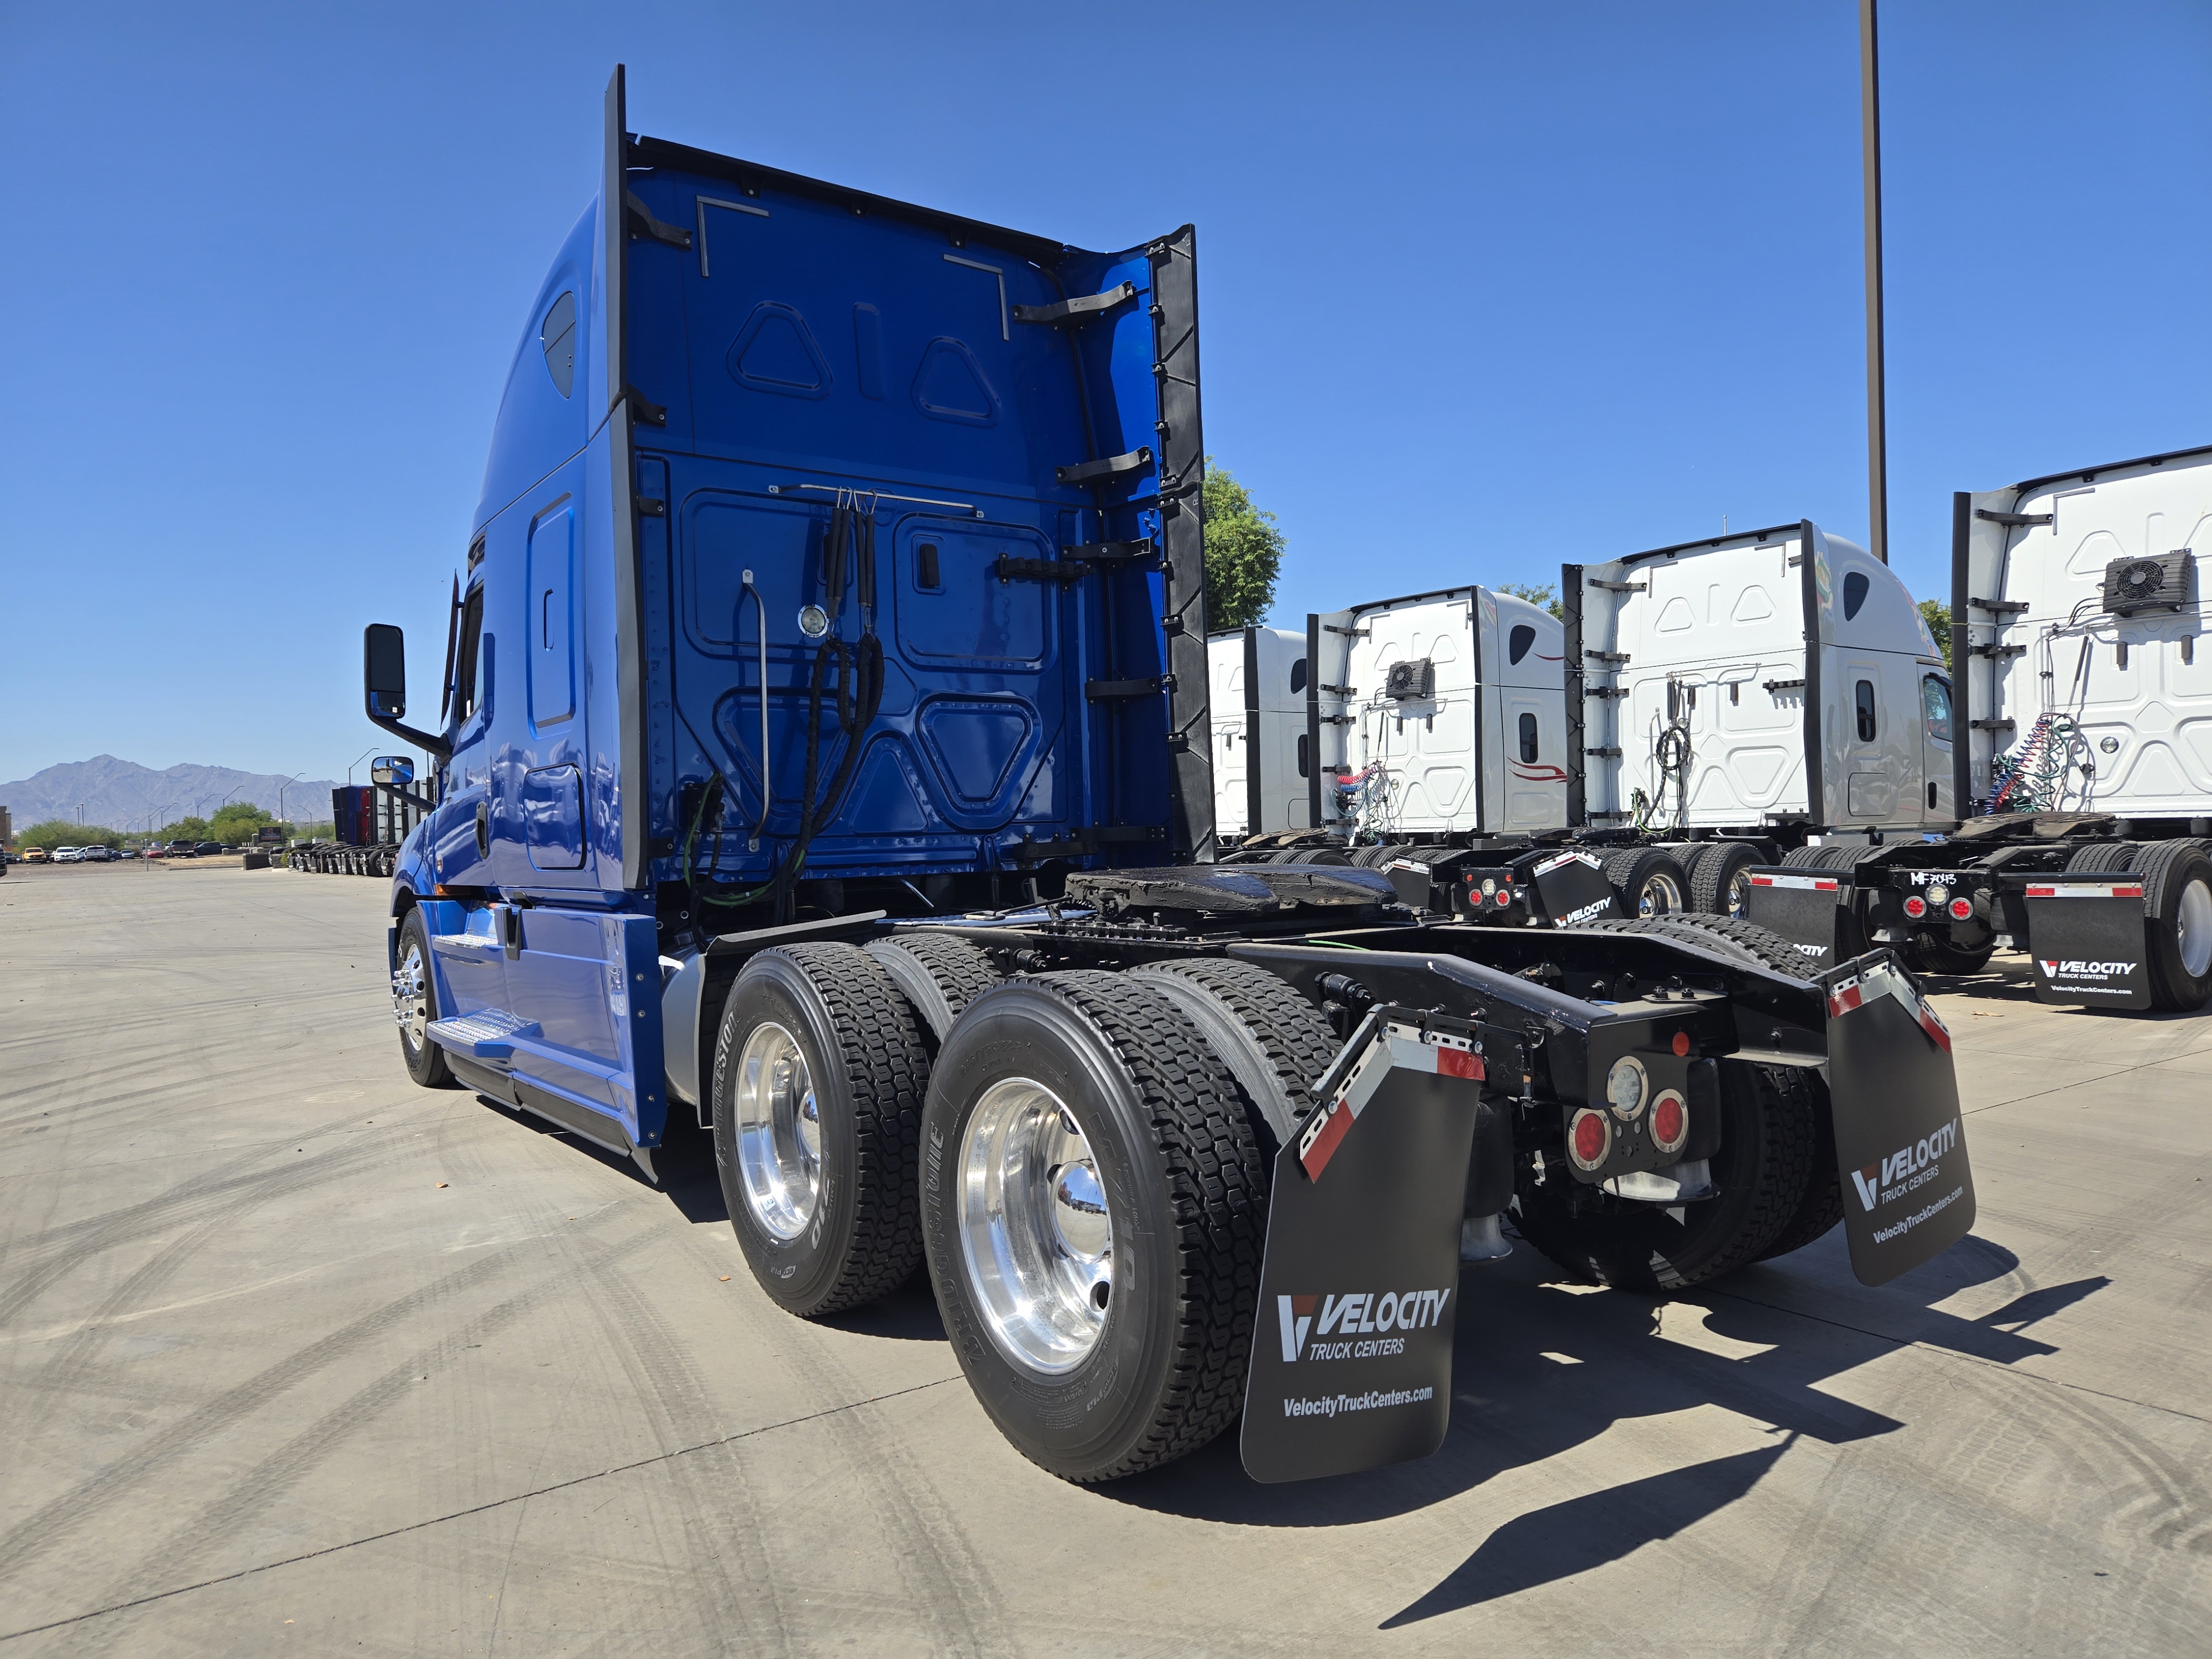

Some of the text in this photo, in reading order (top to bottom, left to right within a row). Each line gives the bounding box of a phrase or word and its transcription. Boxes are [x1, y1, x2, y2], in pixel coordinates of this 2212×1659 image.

[1911, 872, 1957, 885] MF7043
[1567, 896, 1611, 923] VELOCITY
[2059, 961, 2137, 974] VELOCITY
[2051, 985, 2132, 995] VelocityTruckCenters.com
[1882, 1117, 1957, 1187] VELOCITY
[1881, 1164, 1939, 1204] TRUCK CENTERS
[1873, 1186, 1963, 1244] VelocityTruckCenters.com
[1317, 1288, 1451, 1335] VELOCITY
[1310, 1337, 1405, 1361] TRUCK CENTERS
[1284, 1386, 1433, 1418] VelocityTruckCenters.com
